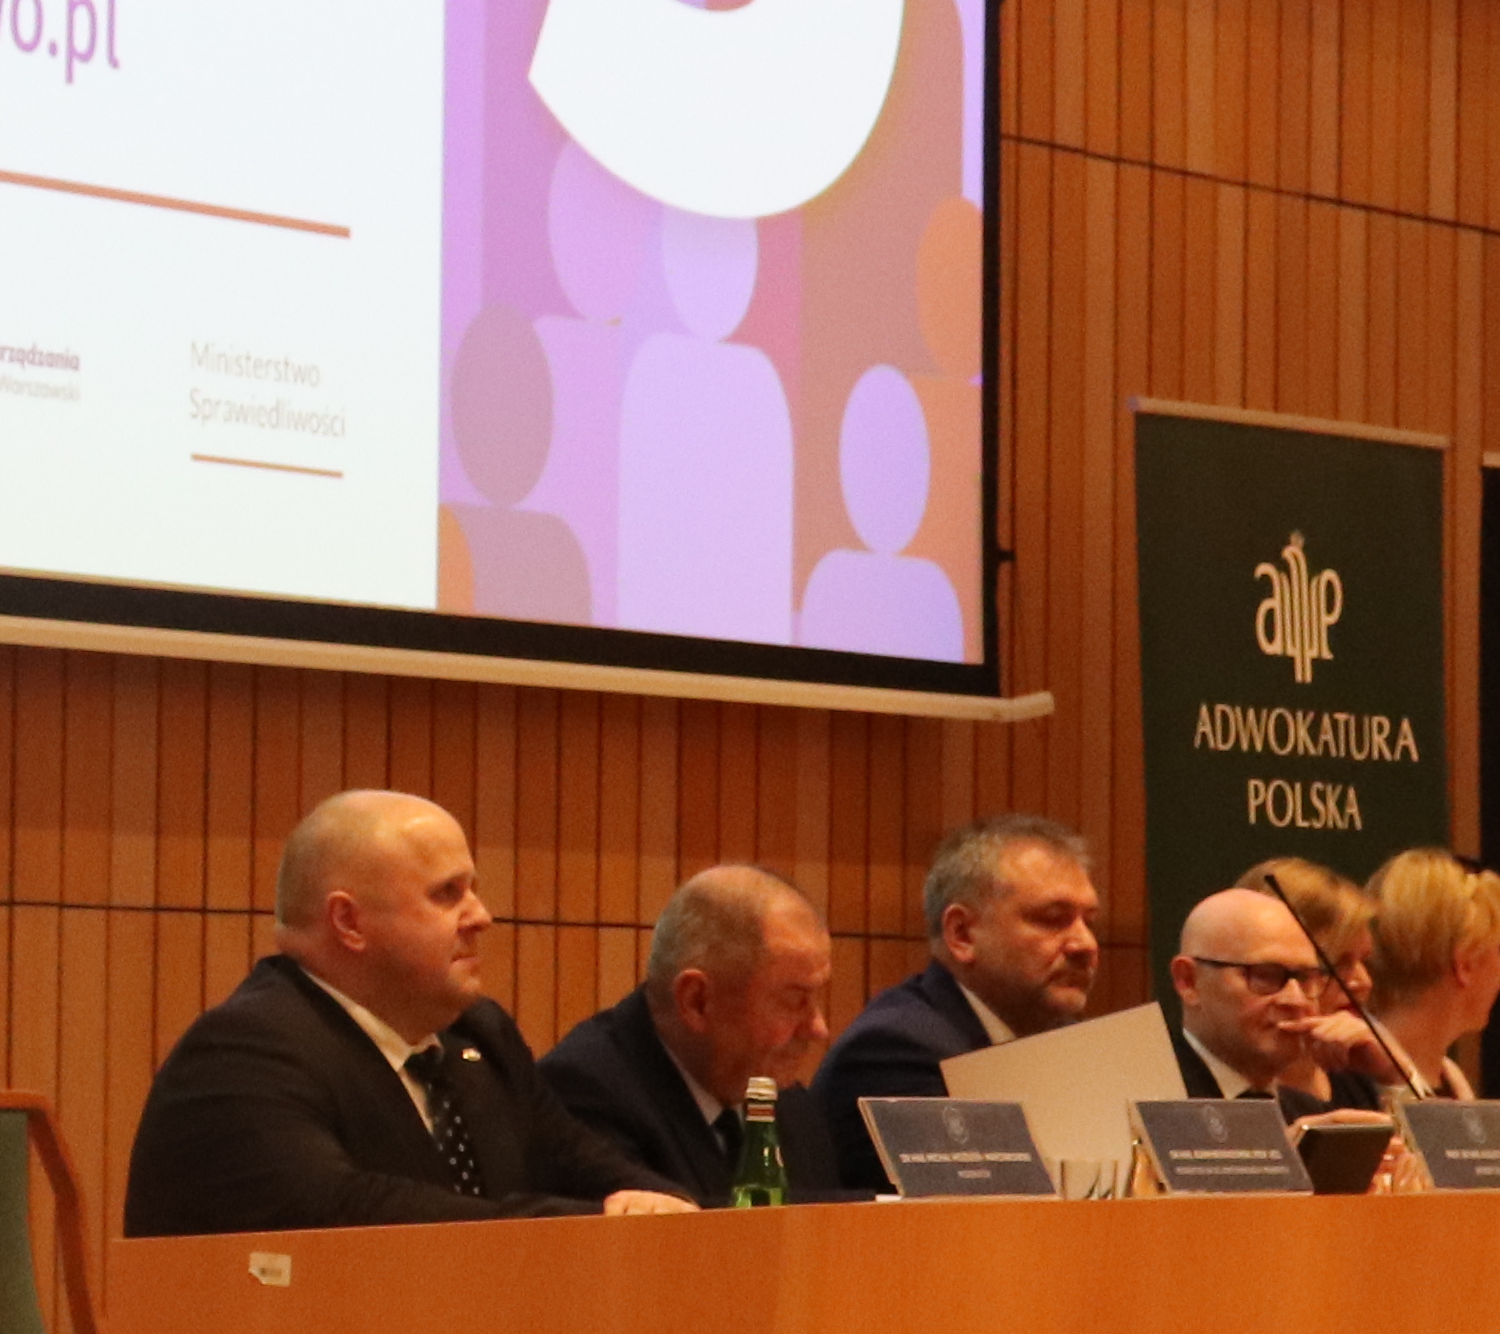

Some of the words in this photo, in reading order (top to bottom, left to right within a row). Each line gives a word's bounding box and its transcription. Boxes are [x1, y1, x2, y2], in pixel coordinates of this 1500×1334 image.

[190, 340, 321, 388] Ministerstwo
[1194, 701, 1420, 763] ADWOKATURA
[1246, 778, 1363, 832] POLSKA
